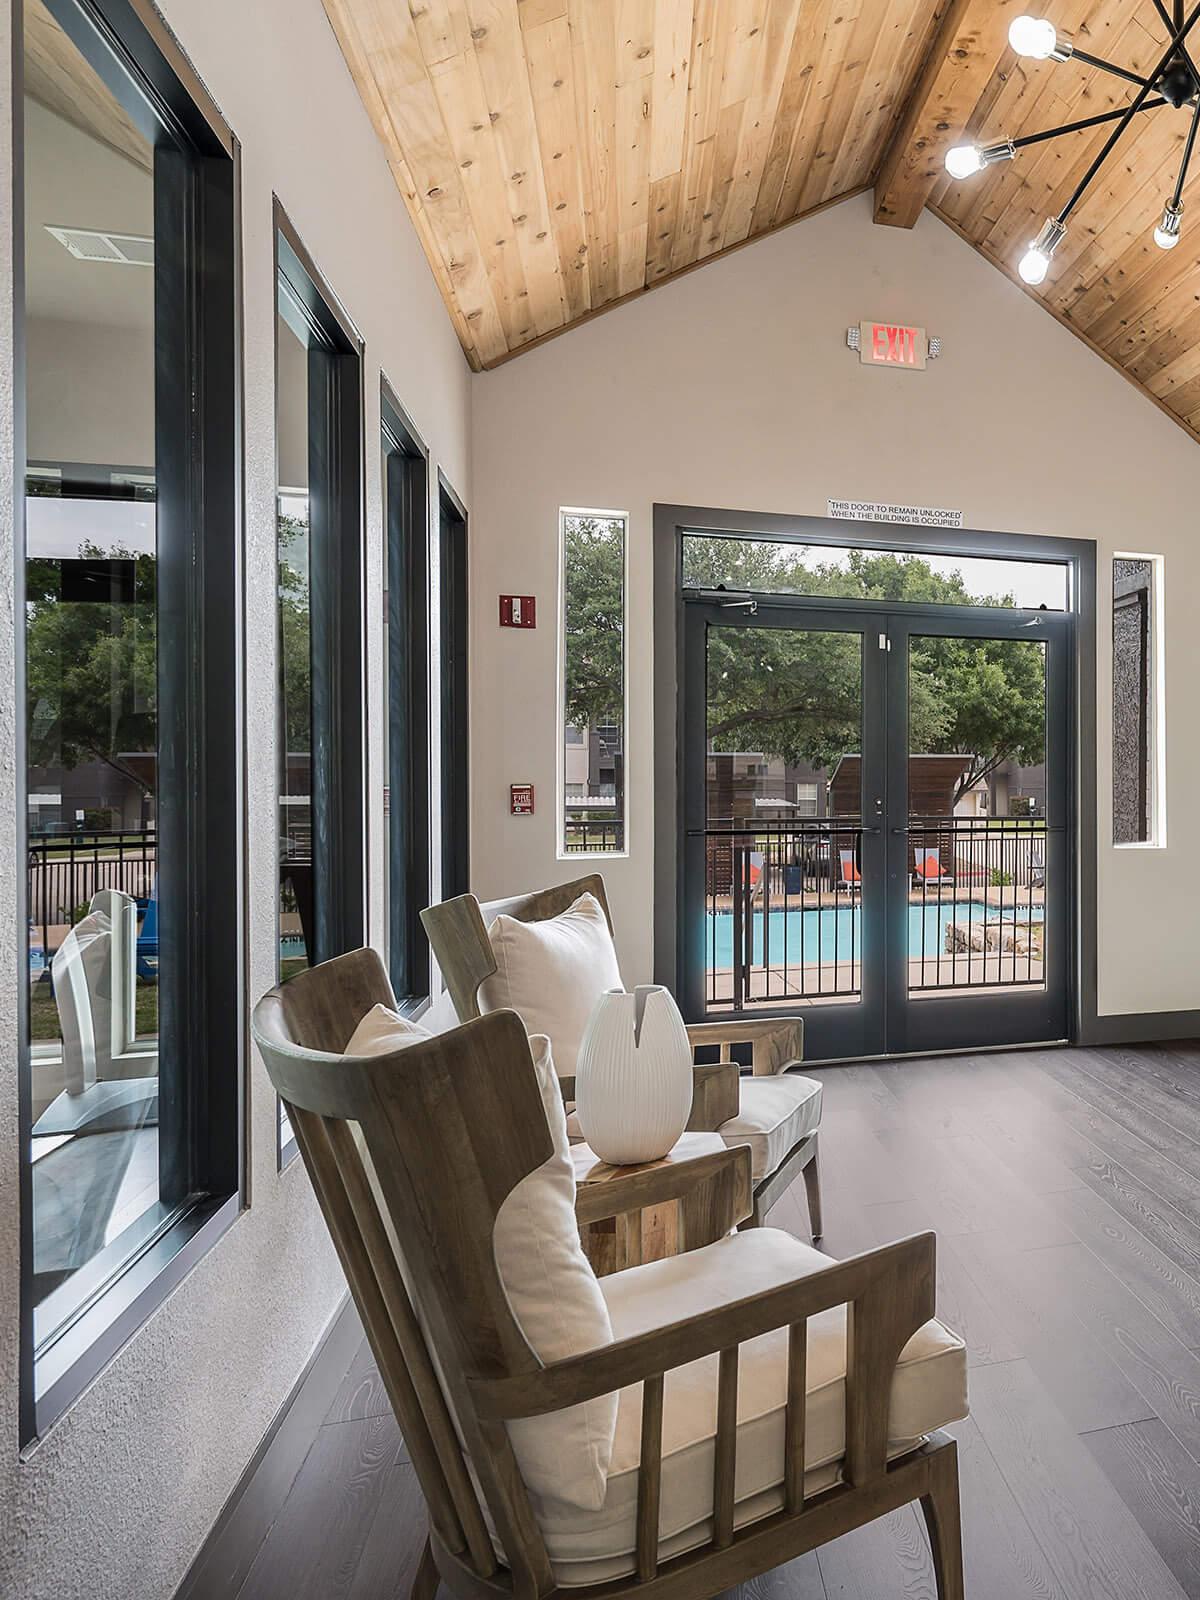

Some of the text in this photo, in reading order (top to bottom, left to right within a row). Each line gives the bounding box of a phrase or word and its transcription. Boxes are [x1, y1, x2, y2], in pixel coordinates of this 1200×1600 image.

[872, 323, 918, 363] EXIT
[831, 501, 961, 519] THIS DOOR TO REMAIN UNLOCKED
[831, 510, 855, 518] WHEN
[858, 512, 873, 520] THE
[874, 513, 910, 522] BUILDING
[921, 517, 960, 527] OCCUPIED
